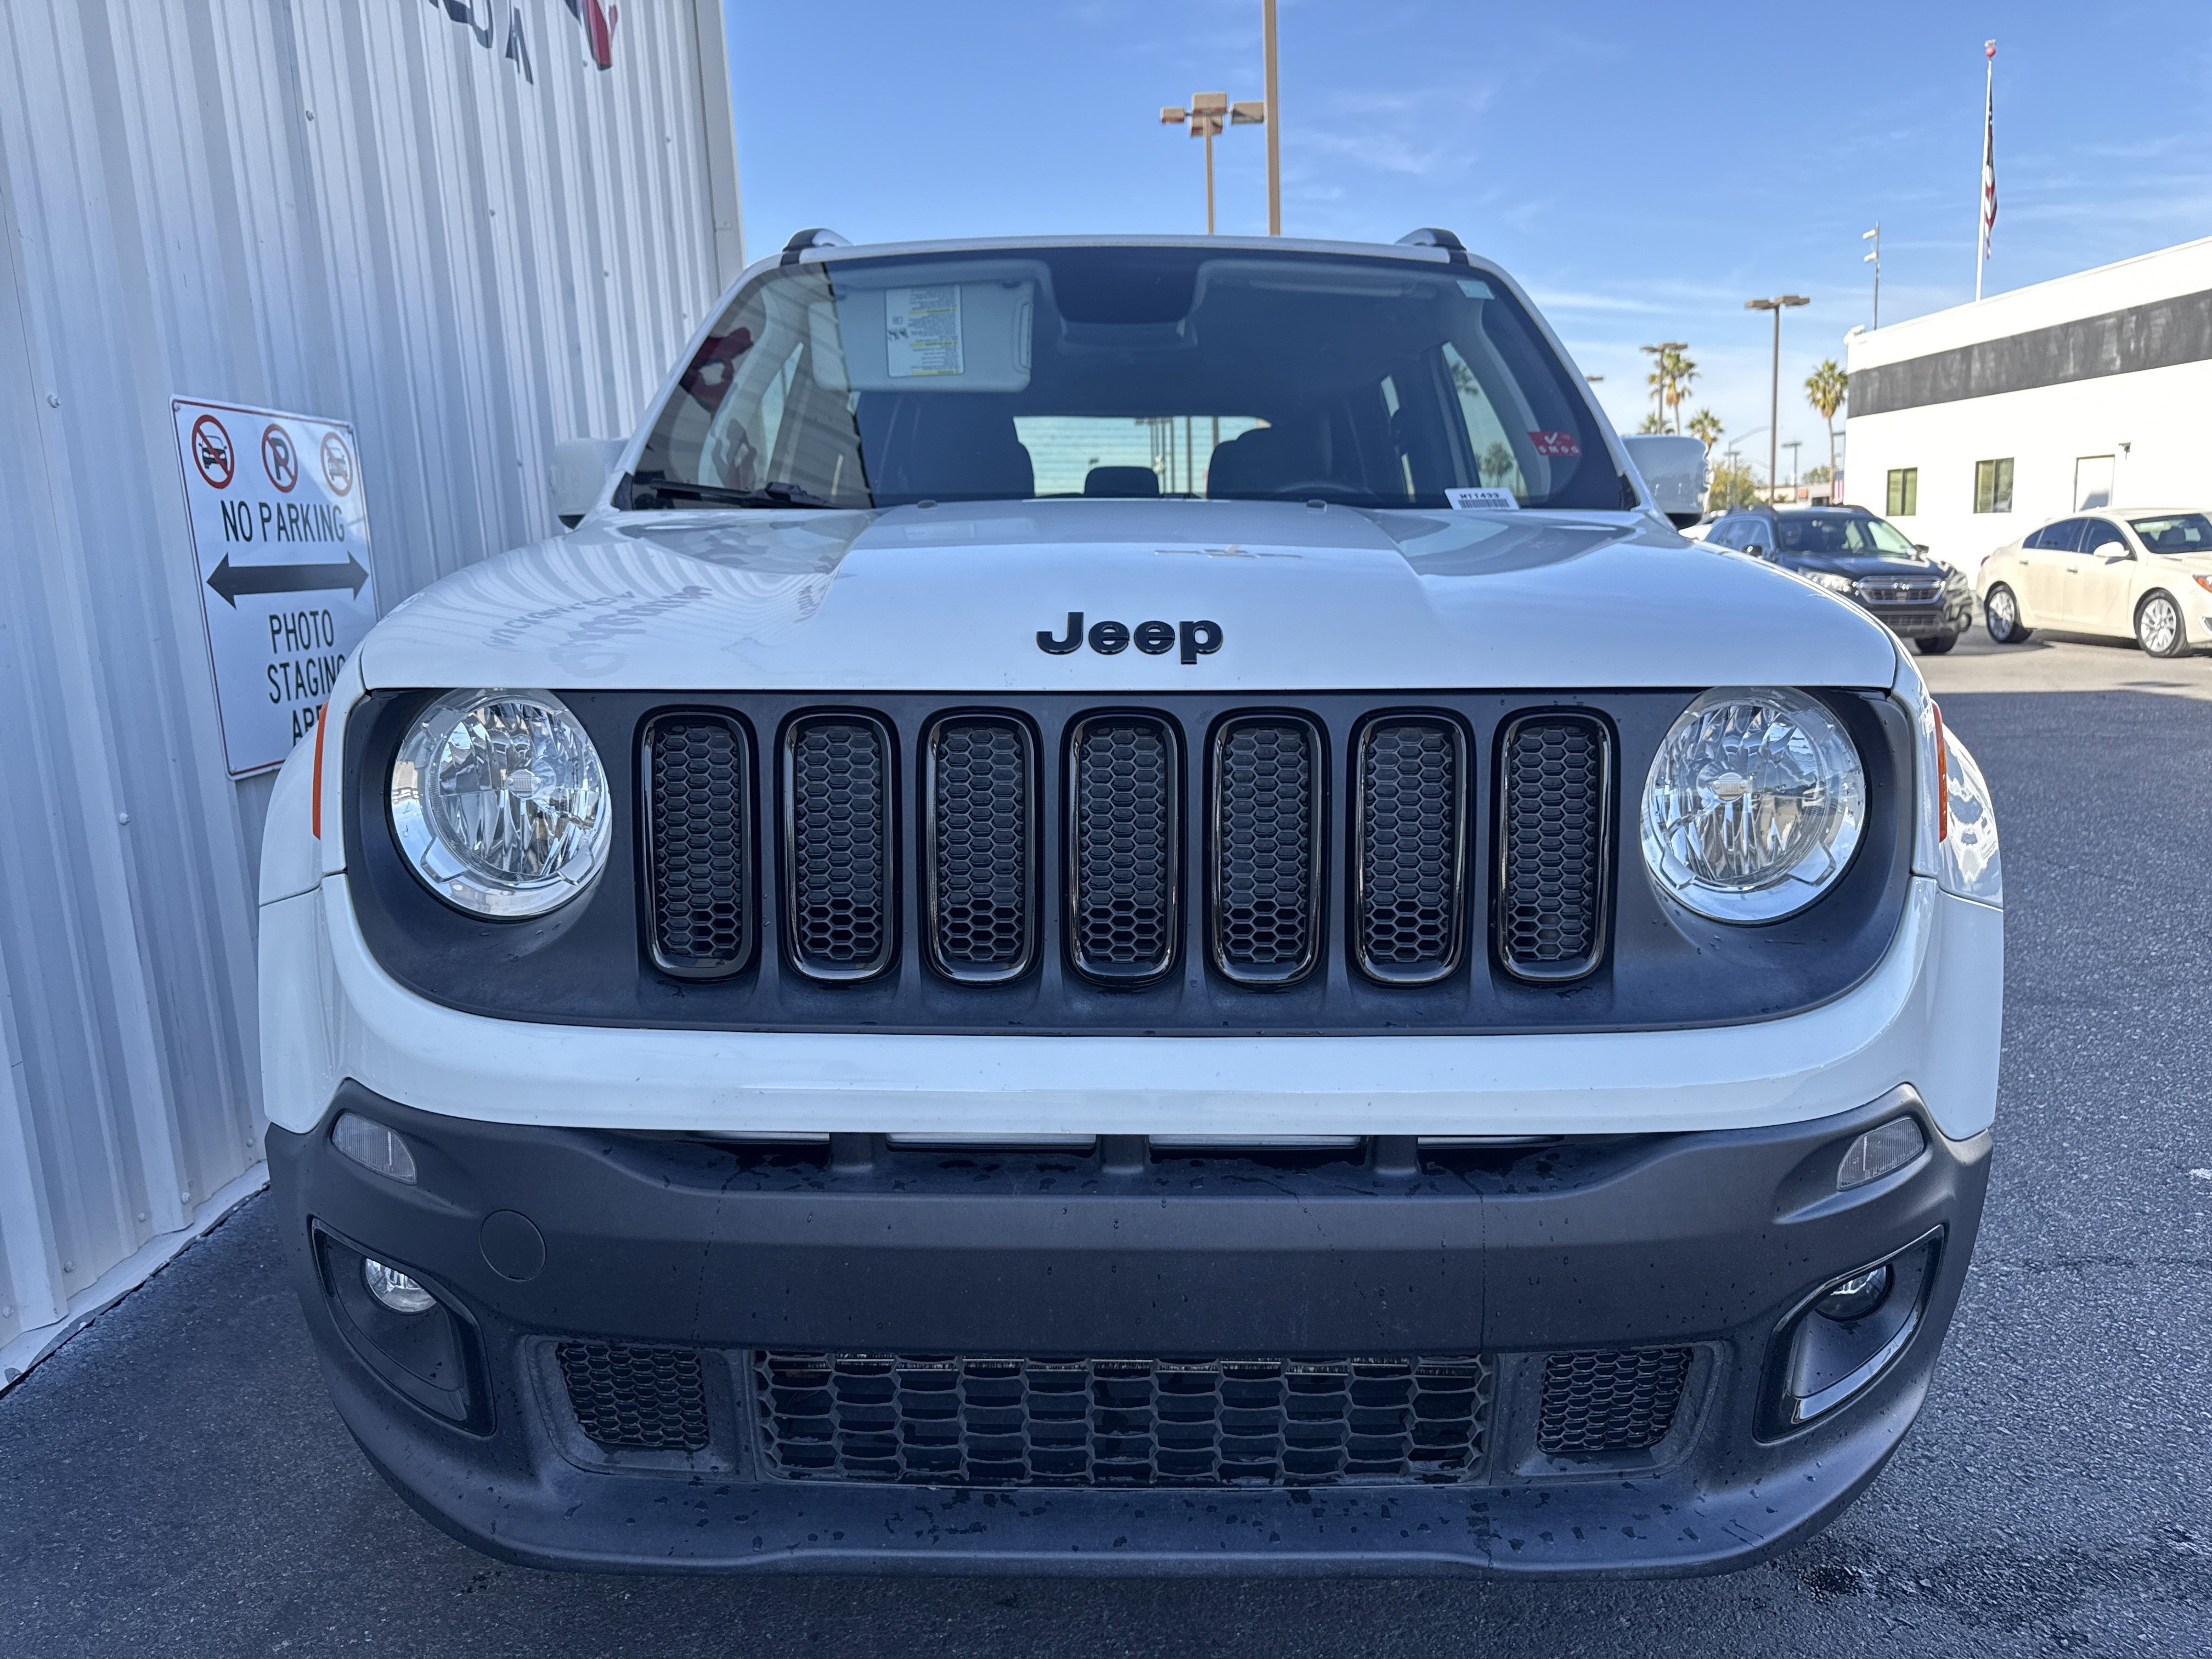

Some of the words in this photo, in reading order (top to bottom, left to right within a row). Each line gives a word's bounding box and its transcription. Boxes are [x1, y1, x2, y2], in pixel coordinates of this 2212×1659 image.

[1538, 444, 1581, 454] SMOG
[220, 500, 253, 542] NO
[258, 501, 345, 542] PARKING
[269, 609, 334, 654] PHOTO
[1036, 611, 1223, 665] Jeep
[292, 704, 323, 748] AR
